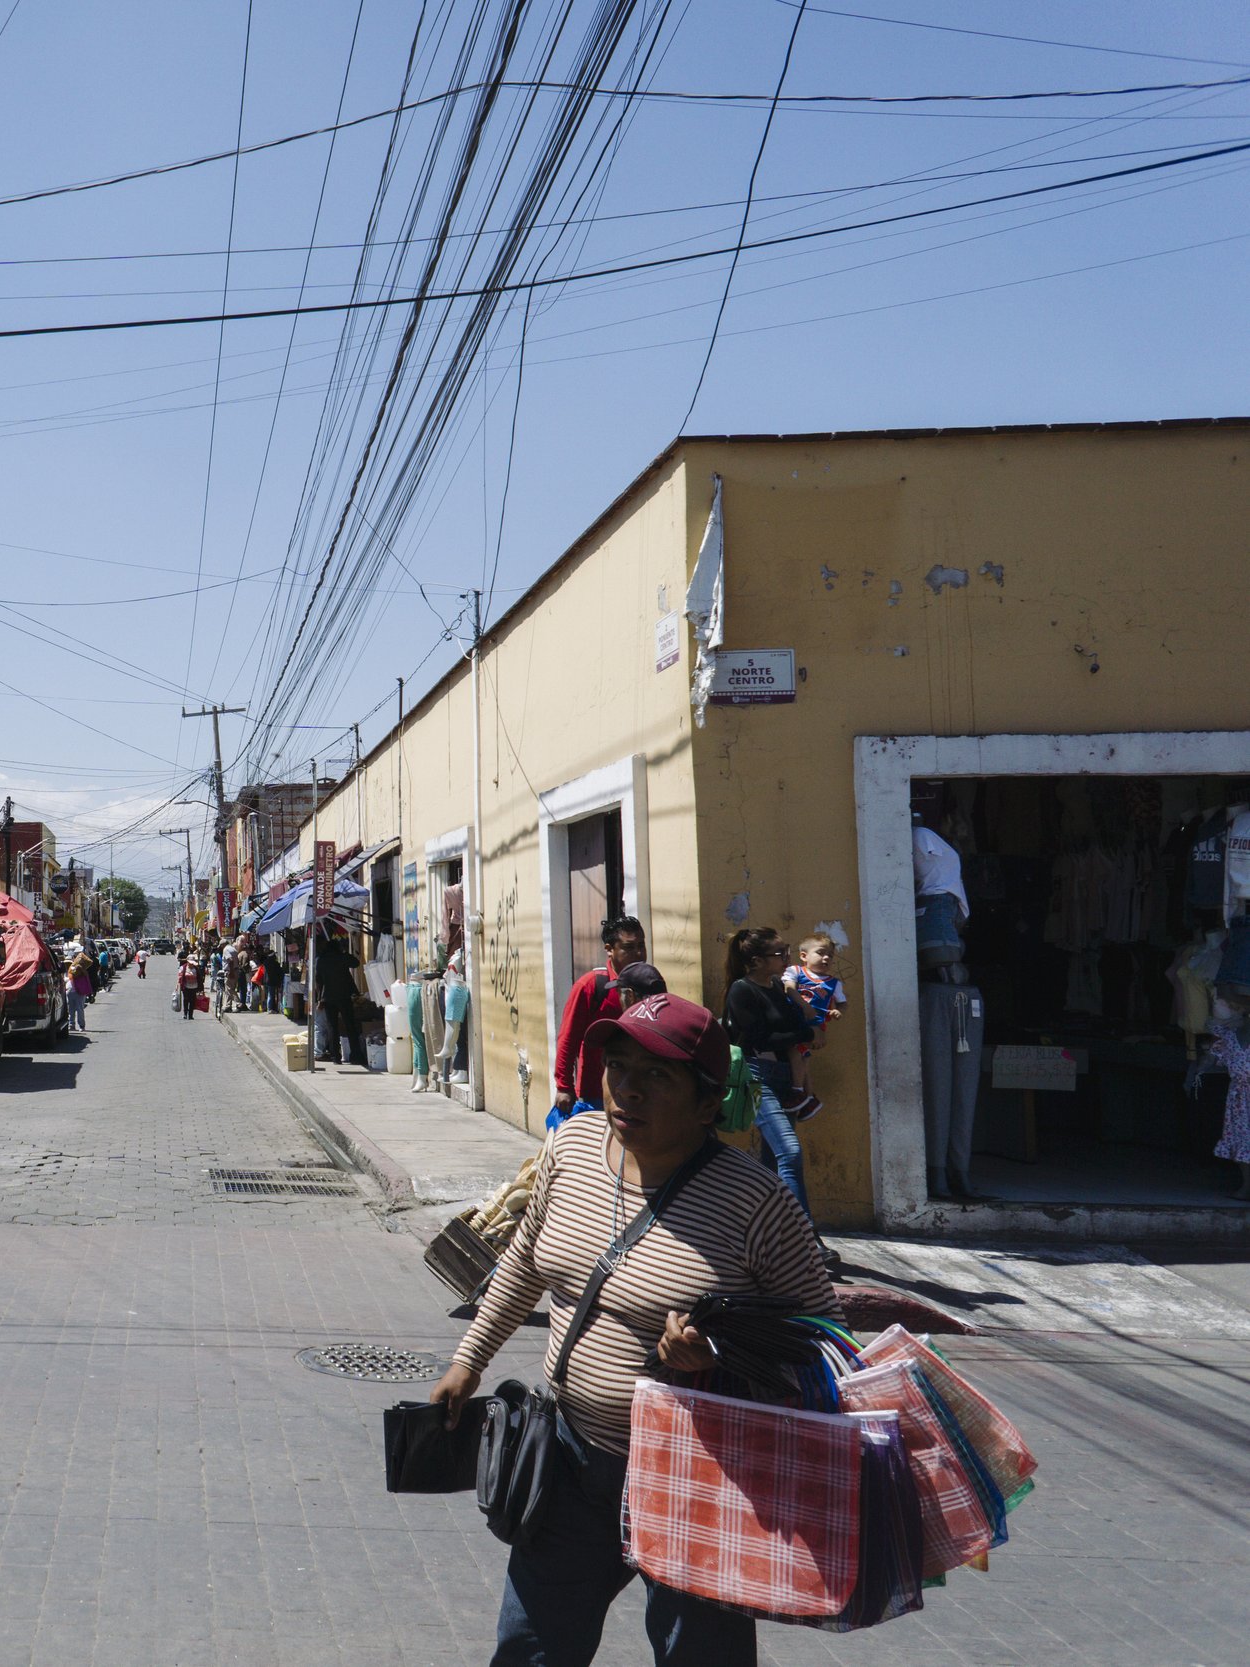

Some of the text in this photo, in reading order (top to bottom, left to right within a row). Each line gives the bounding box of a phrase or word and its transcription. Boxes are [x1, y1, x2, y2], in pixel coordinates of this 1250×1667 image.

[747, 658, 754, 667] 5
[731, 667, 772, 676] NORTE
[727, 676, 775, 685] CENTRO
[1192, 850, 1222, 862] adidas
[317, 871, 325, 882] DE
[325, 845, 334, 910] PARQUIMETRO
[317, 883, 325, 909] ZONA
[222, 891, 231, 927] CEMITAS
